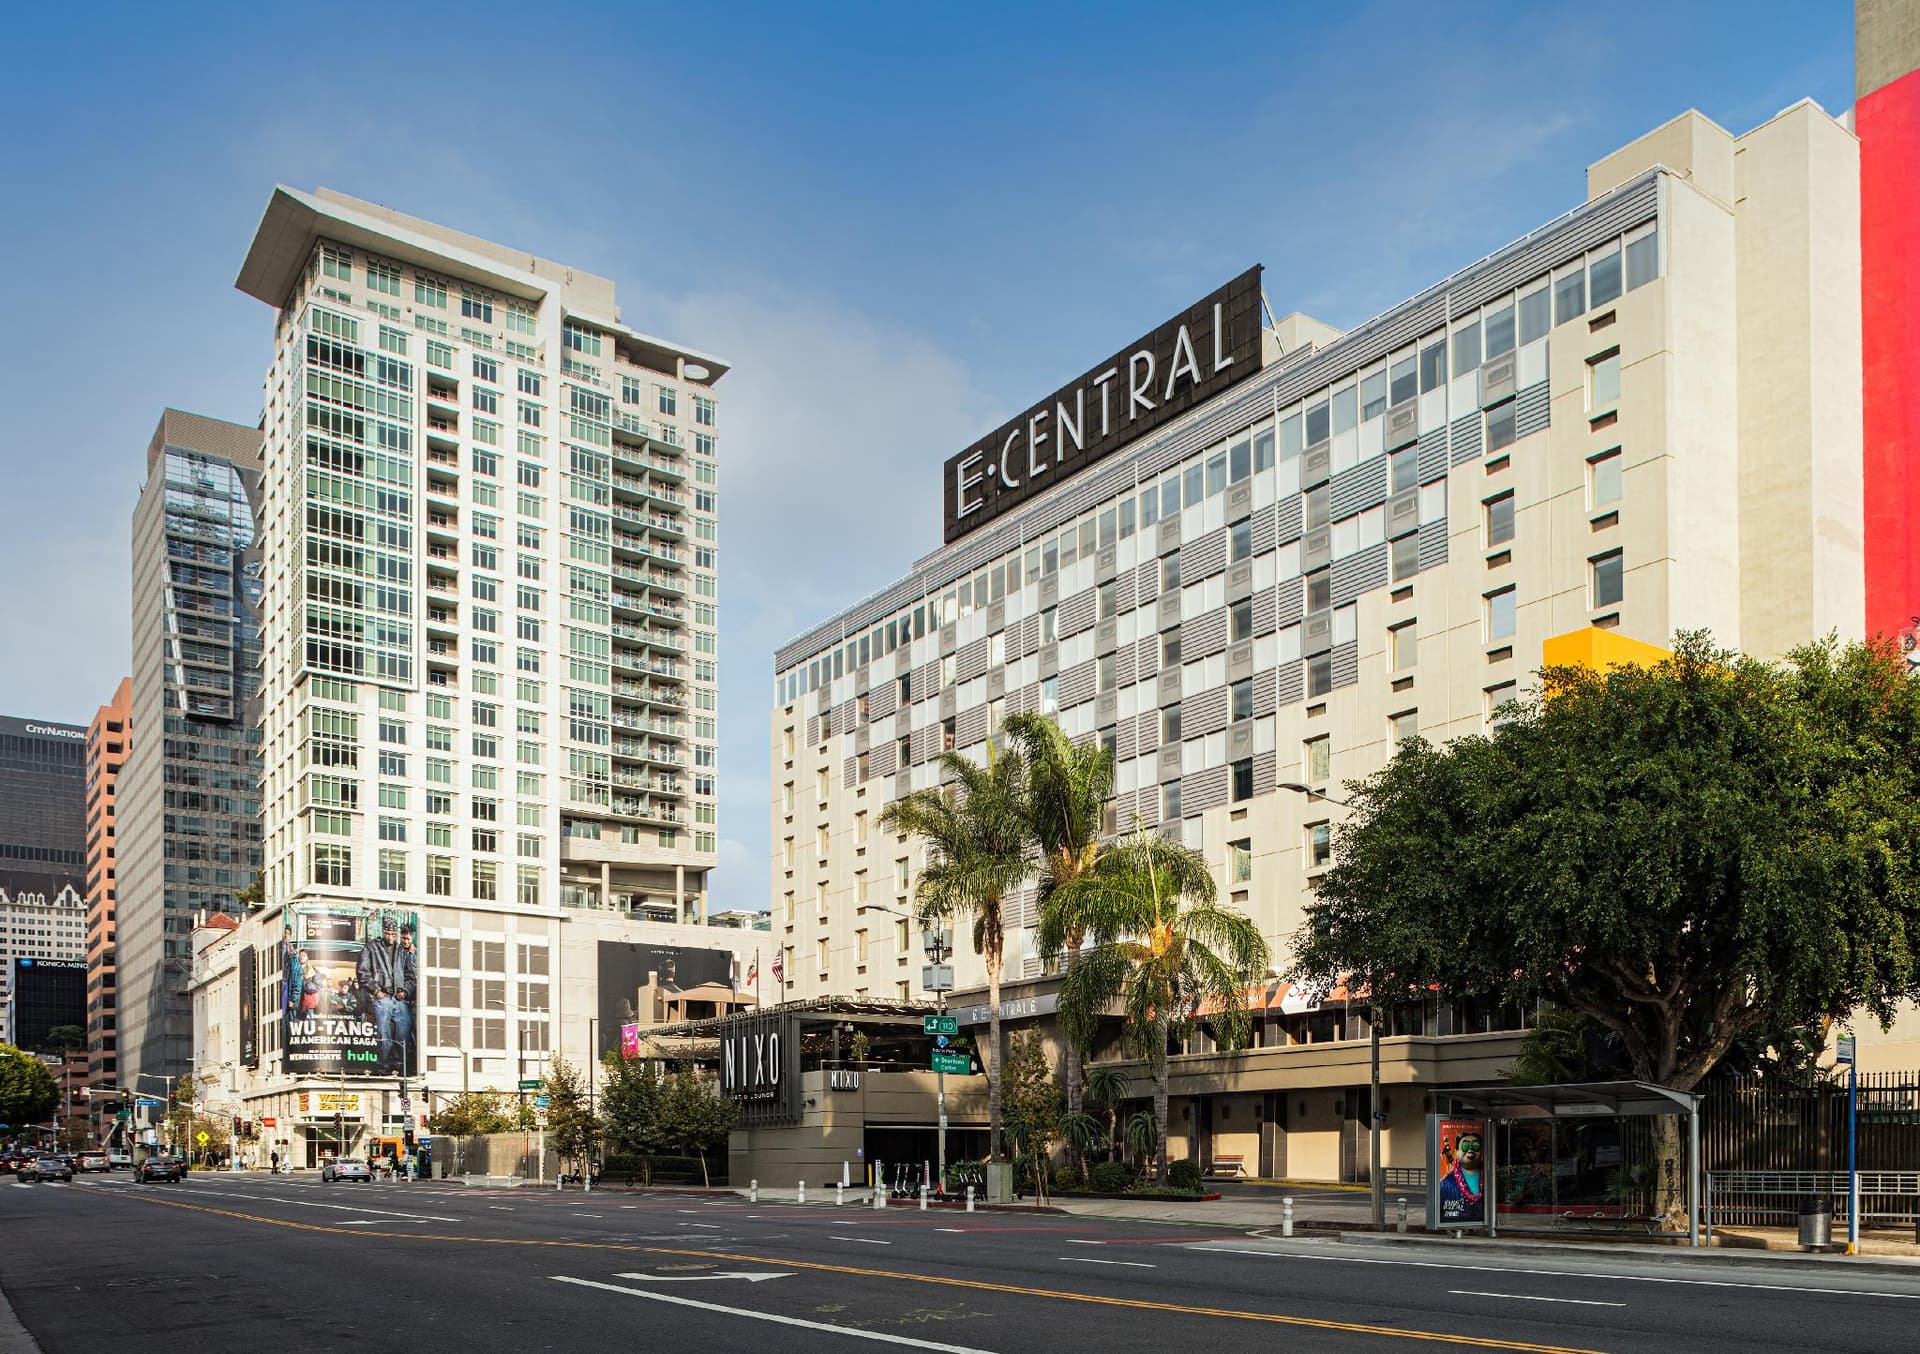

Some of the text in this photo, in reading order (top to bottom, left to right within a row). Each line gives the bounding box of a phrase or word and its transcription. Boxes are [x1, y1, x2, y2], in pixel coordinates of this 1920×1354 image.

[289, 1020, 378, 1036] WU-TANG:
[301, 1036, 351, 1045] AMERICAN
[353, 1037, 377, 1046] SAGA
[347, 1050, 378, 1062] hulu
[725, 1032, 779, 1089] NIXO
[831, 1072, 859, 1089] NIXO
